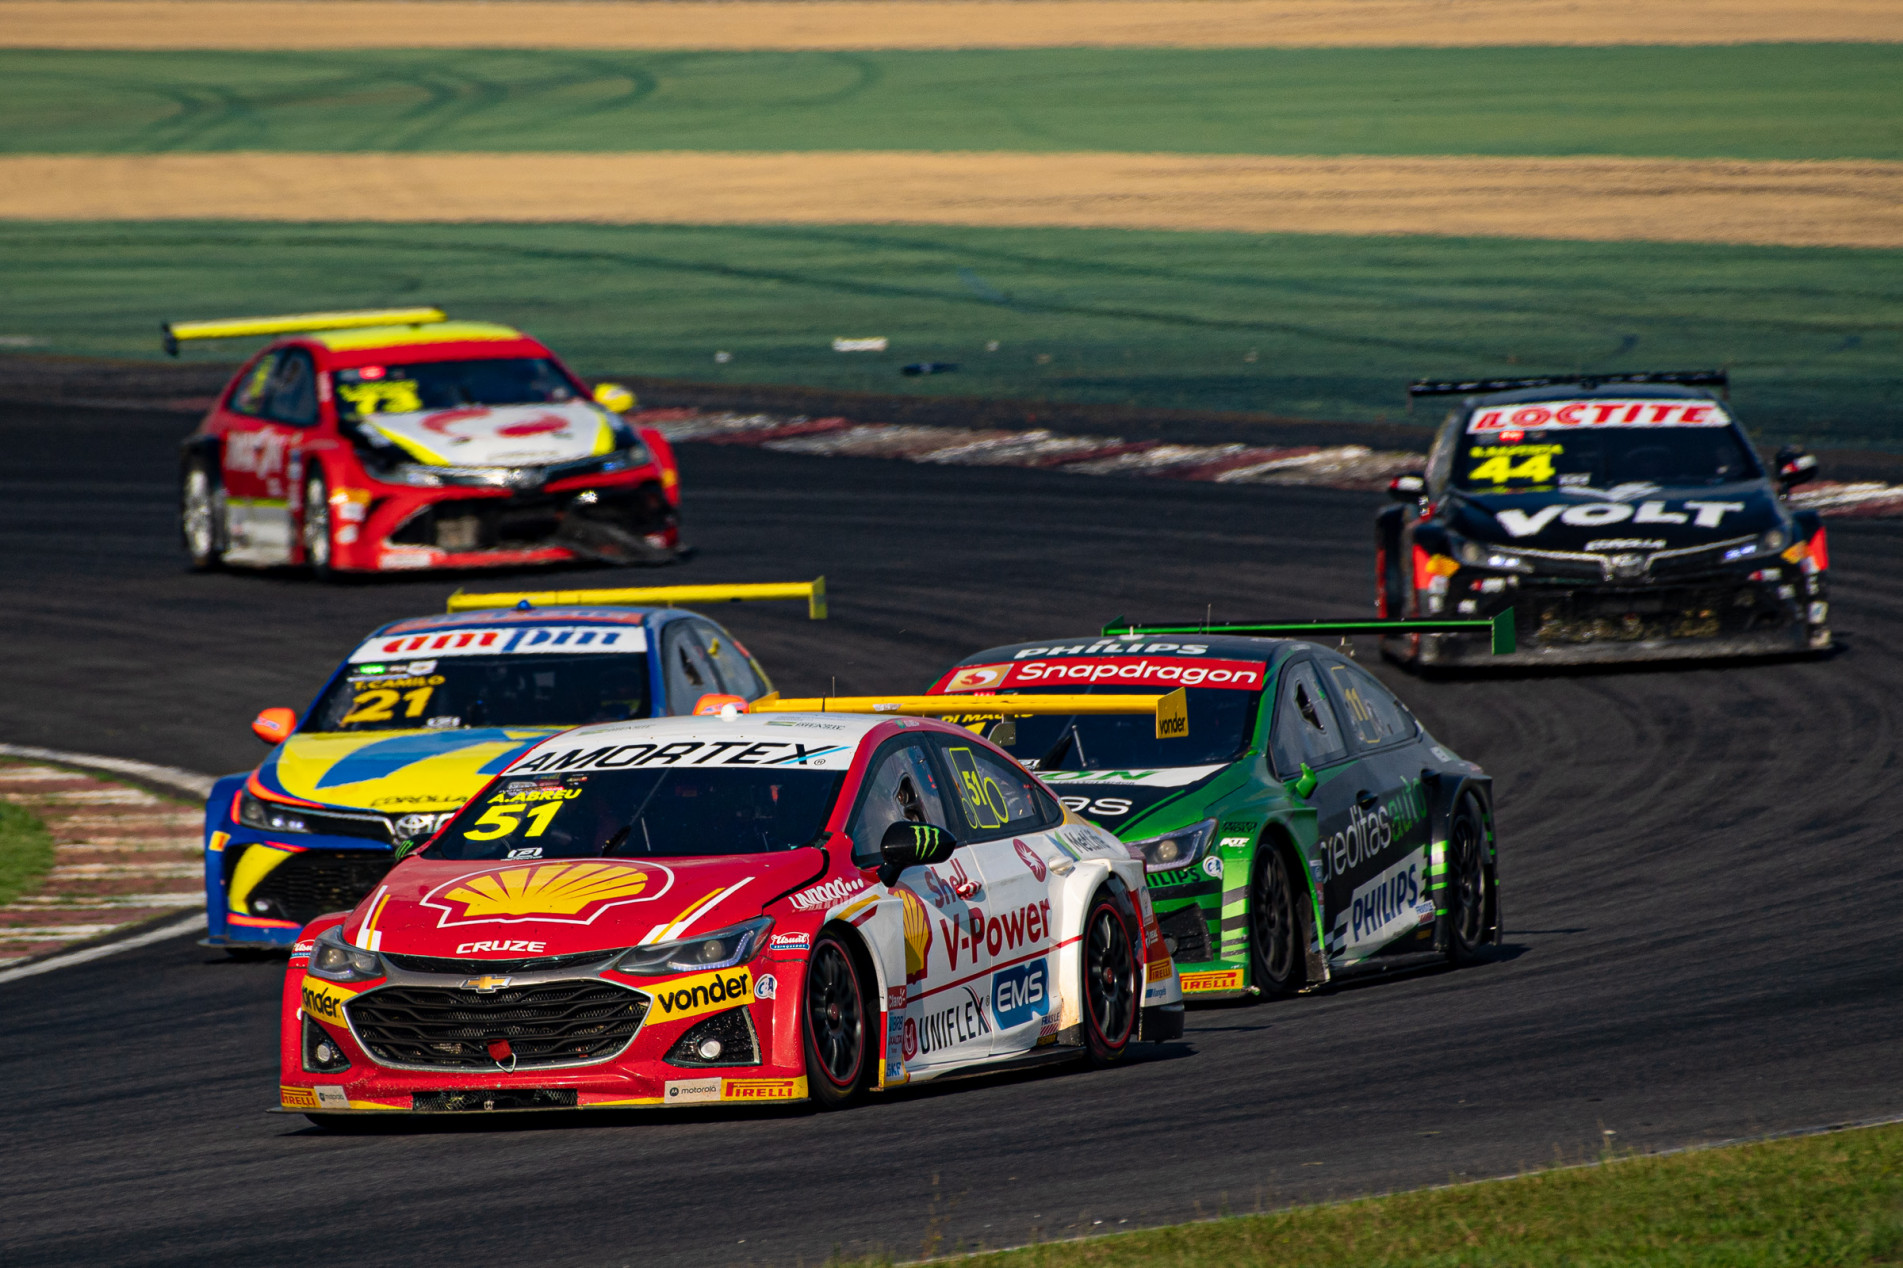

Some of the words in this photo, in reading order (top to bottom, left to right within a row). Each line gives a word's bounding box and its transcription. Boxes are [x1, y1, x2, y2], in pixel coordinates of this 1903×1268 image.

[1474, 403, 1716, 430] LOCTITE
[1468, 455, 1556, 484] 44
[1496, 501, 1745, 537] VOLT
[1014, 641, 1209, 660] PHILIPS
[1016, 660, 1257, 685] Snapdragon
[342, 687, 434, 725] 21
[1159, 711, 1186, 735] vonder
[507, 741, 843, 773] AMORTEX
[487, 788, 583, 804] A.ABREU
[962, 771, 988, 806] 51
[463, 801, 563, 841] 51
[924, 858, 968, 909] Shell
[1146, 868, 1201, 887] ILIPS
[1352, 863, 1418, 942] PHILIPS
[456, 940, 547, 955] CRUZE
[939, 898, 1051, 972] V-Power
[1149, 961, 1171, 983] PIRELLI
[657, 973, 748, 1013] vonder
[997, 971, 1043, 1013] EMS
[918, 993, 991, 1055] UNIFLEX
[681, 1086, 717, 1095] motorola
[725, 1081, 794, 1097] PIRELLI
